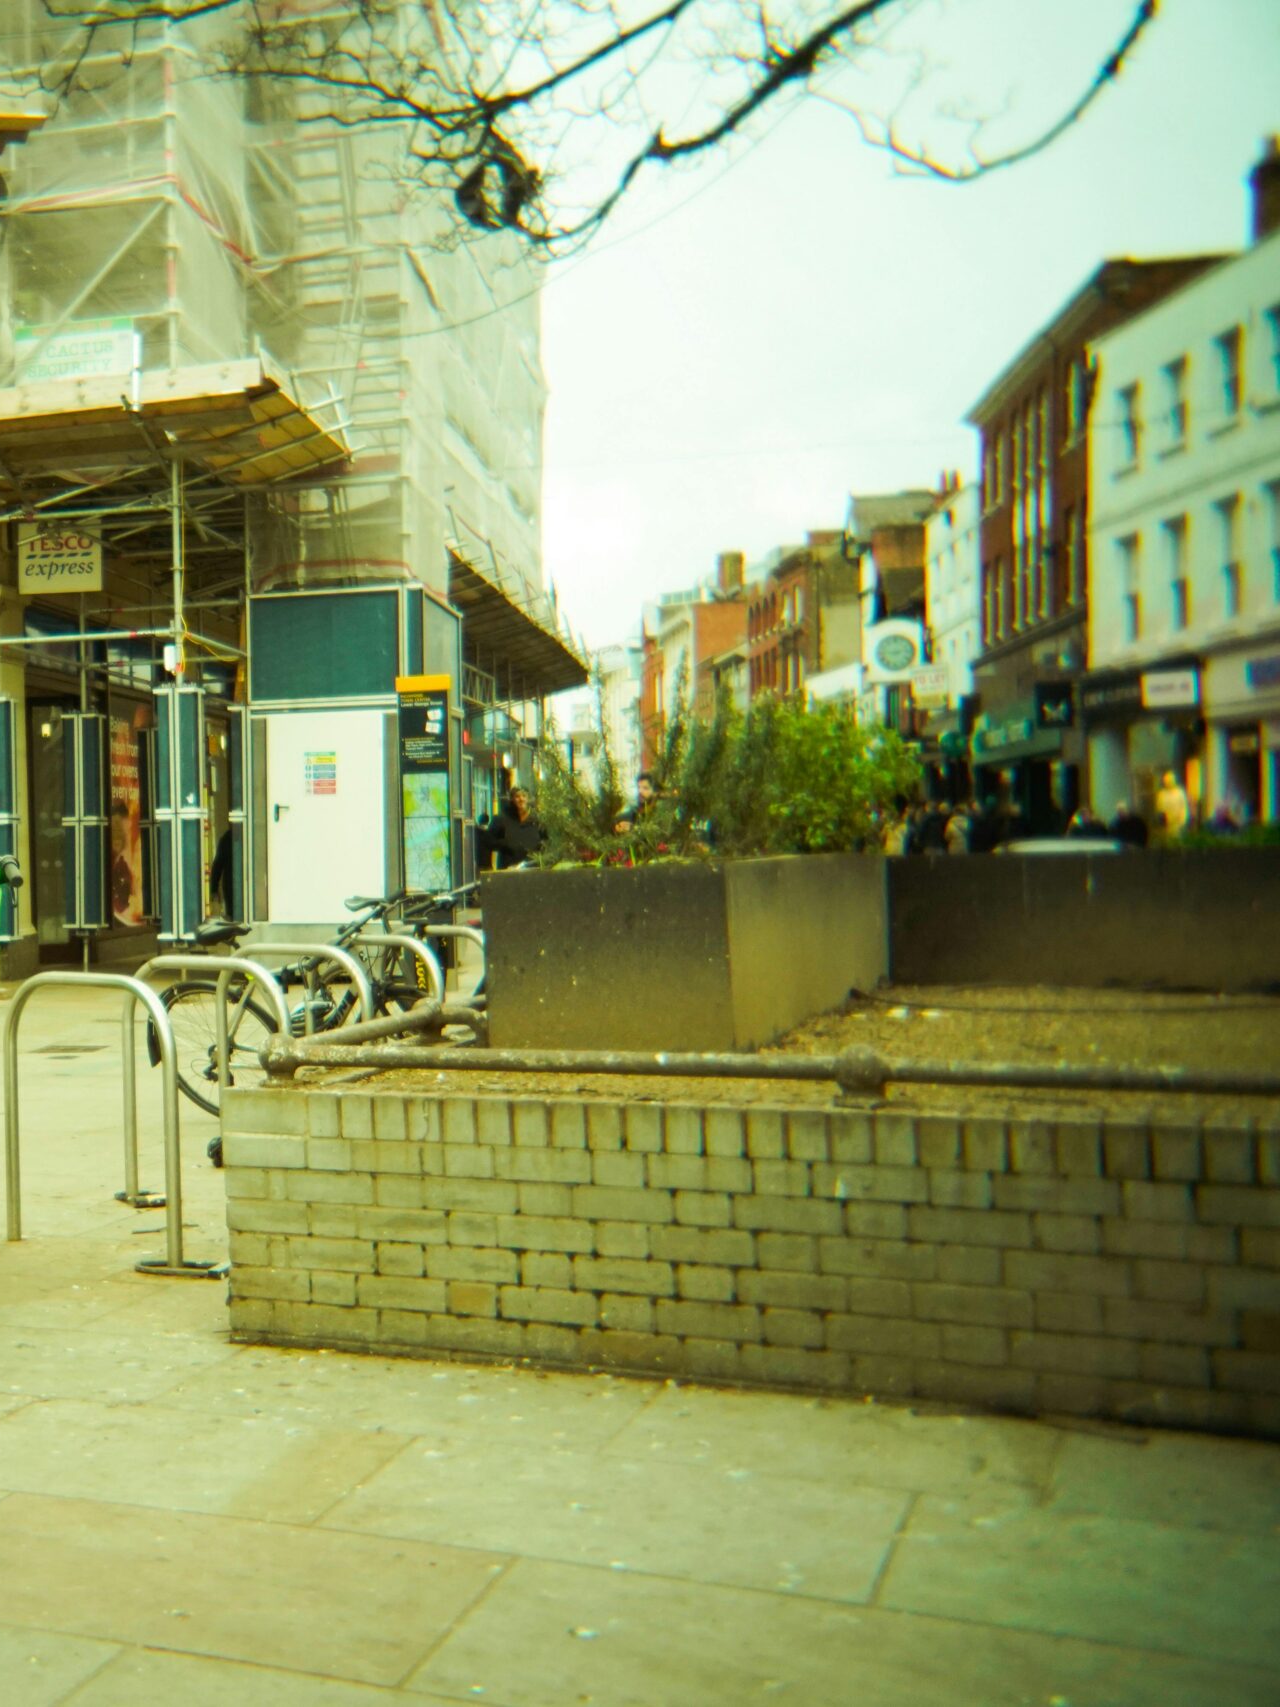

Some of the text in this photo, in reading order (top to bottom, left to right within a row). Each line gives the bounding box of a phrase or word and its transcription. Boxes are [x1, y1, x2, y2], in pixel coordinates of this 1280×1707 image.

[46, 341, 113, 358] CACTUS
[27, 359, 112, 378] SECURITY
[29, 535, 94, 552] TESCO
[25, 561, 95, 580] express
